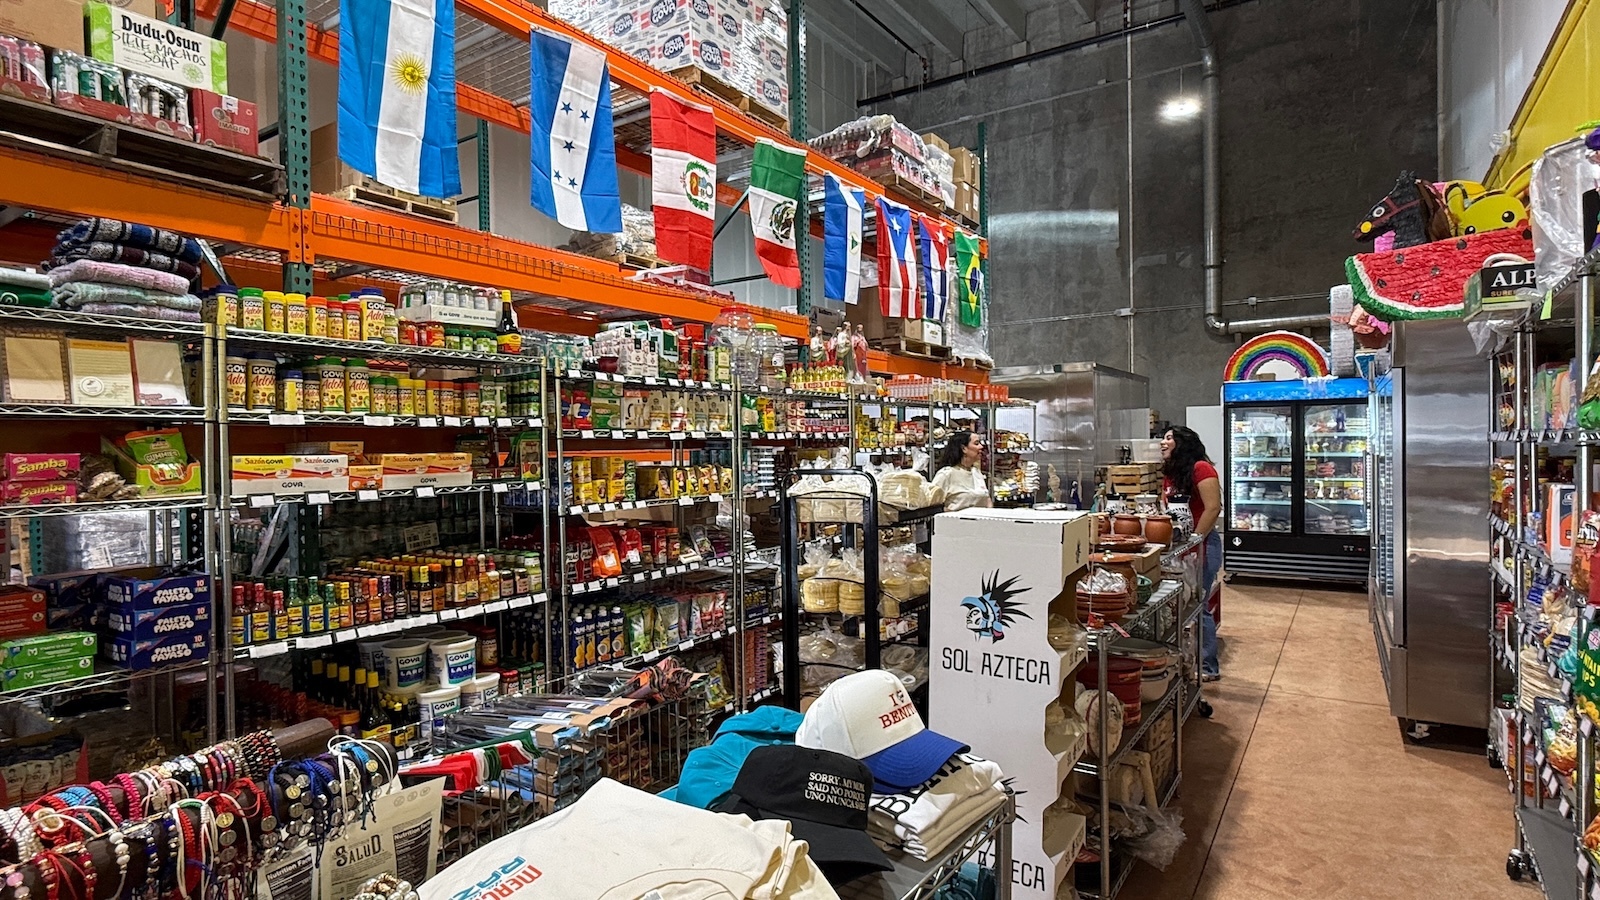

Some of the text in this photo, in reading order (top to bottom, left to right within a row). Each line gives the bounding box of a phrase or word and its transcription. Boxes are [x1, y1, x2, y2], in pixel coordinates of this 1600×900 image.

[652, 3, 676, 25] GOYA
[664, 41, 684, 56] GOYA
[144, 52, 179, 70] SOAP
[702, 50, 722, 65] GOYA
[764, 88, 780, 100] GOYA
[221, 122, 249, 134] IMAGEN
[1490, 269, 1536, 287] ALP
[16, 458, 68, 474] Samba
[20, 484, 66, 498] Samba
[152, 592, 194, 604] PAYASO
[156, 587, 190, 597] PALETA
[154, 620, 194, 633] PAYASO
[156, 615, 190, 625] PALETA
[151, 648, 192, 662] PAYASO
[154, 643, 188, 653] PALETA
[400, 657, 420, 665] GOYA
[449, 653, 469, 662] GOYA
[942, 647, 974, 673] SOL
[981, 652, 1050, 686] AZTECA
[434, 701, 455, 710] GOYA
[889, 693, 898, 706] I
[878, 702, 916, 729] BENIT
[808, 782, 829, 793] SAID
[830, 786, 843, 796] NO
[805, 789, 826, 802] UNO
[826, 794, 854, 808] NUNCA
[335, 834, 380, 867] SALUD
[266, 863, 297, 880] Nutrition
[449, 856, 526, 900] RAZ
[476, 864, 542, 900] MERC
